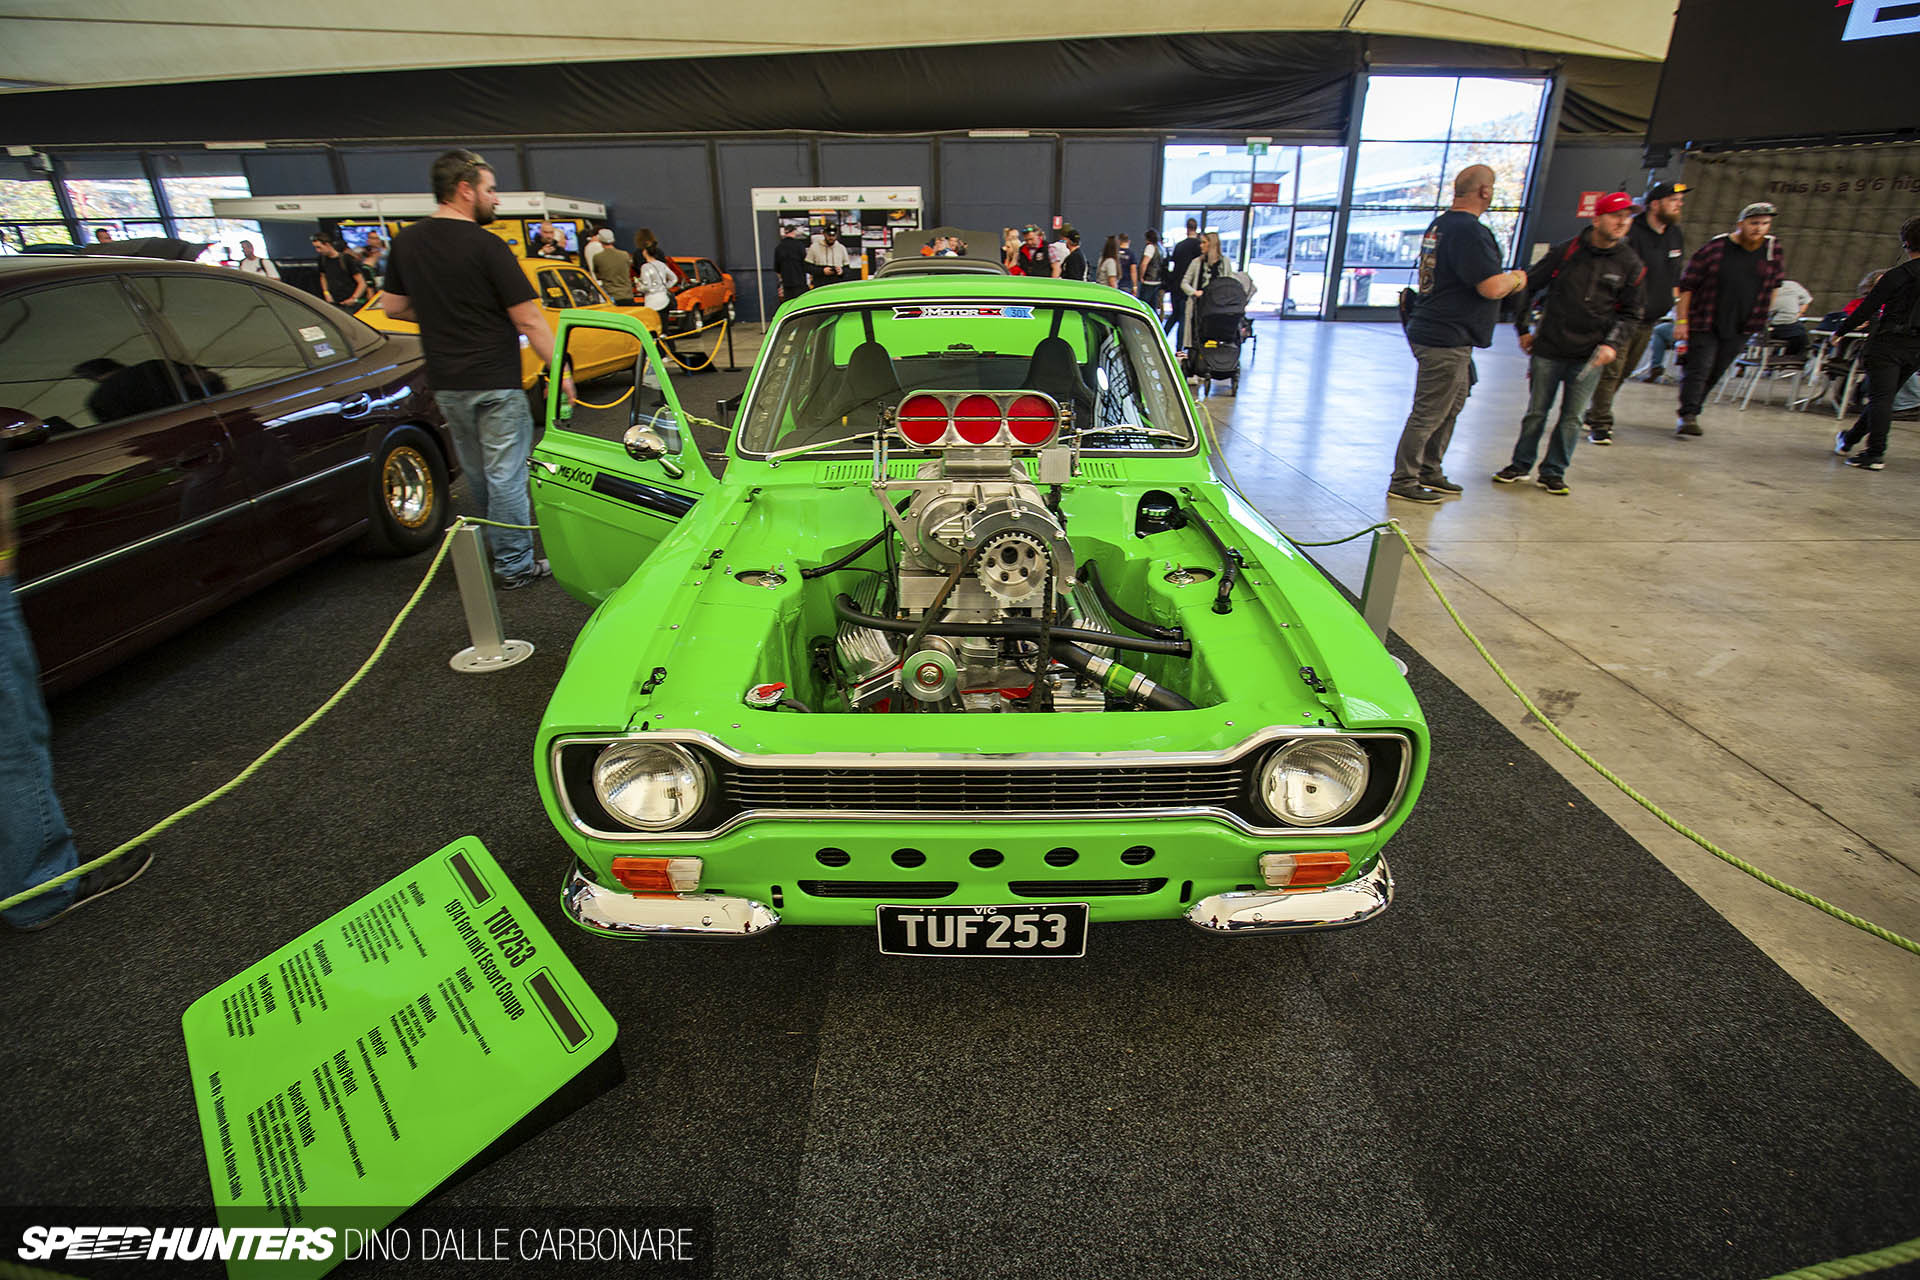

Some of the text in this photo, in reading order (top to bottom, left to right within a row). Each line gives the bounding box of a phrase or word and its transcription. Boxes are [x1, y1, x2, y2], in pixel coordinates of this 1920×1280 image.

[1770, 180, 1808, 193] This
[1814, 180, 1831, 193] is
[1837, 180, 1849, 193] a
[1011, 309, 1027, 318] 301
[558, 465, 593, 485] MEXICO
[484, 906, 536, 967] TUF253
[898, 913, 1067, 948] TUF253
[444, 898, 525, 1020] 1974 Ford mk1 Escort Coupe
[455, 966, 475, 993] Brakes
[416, 992, 437, 1023] Wheels
[367, 1026, 388, 1058] Interior
[333, 1049, 358, 1096] Body/Paint
[287, 1080, 316, 1147] Special Thanks
